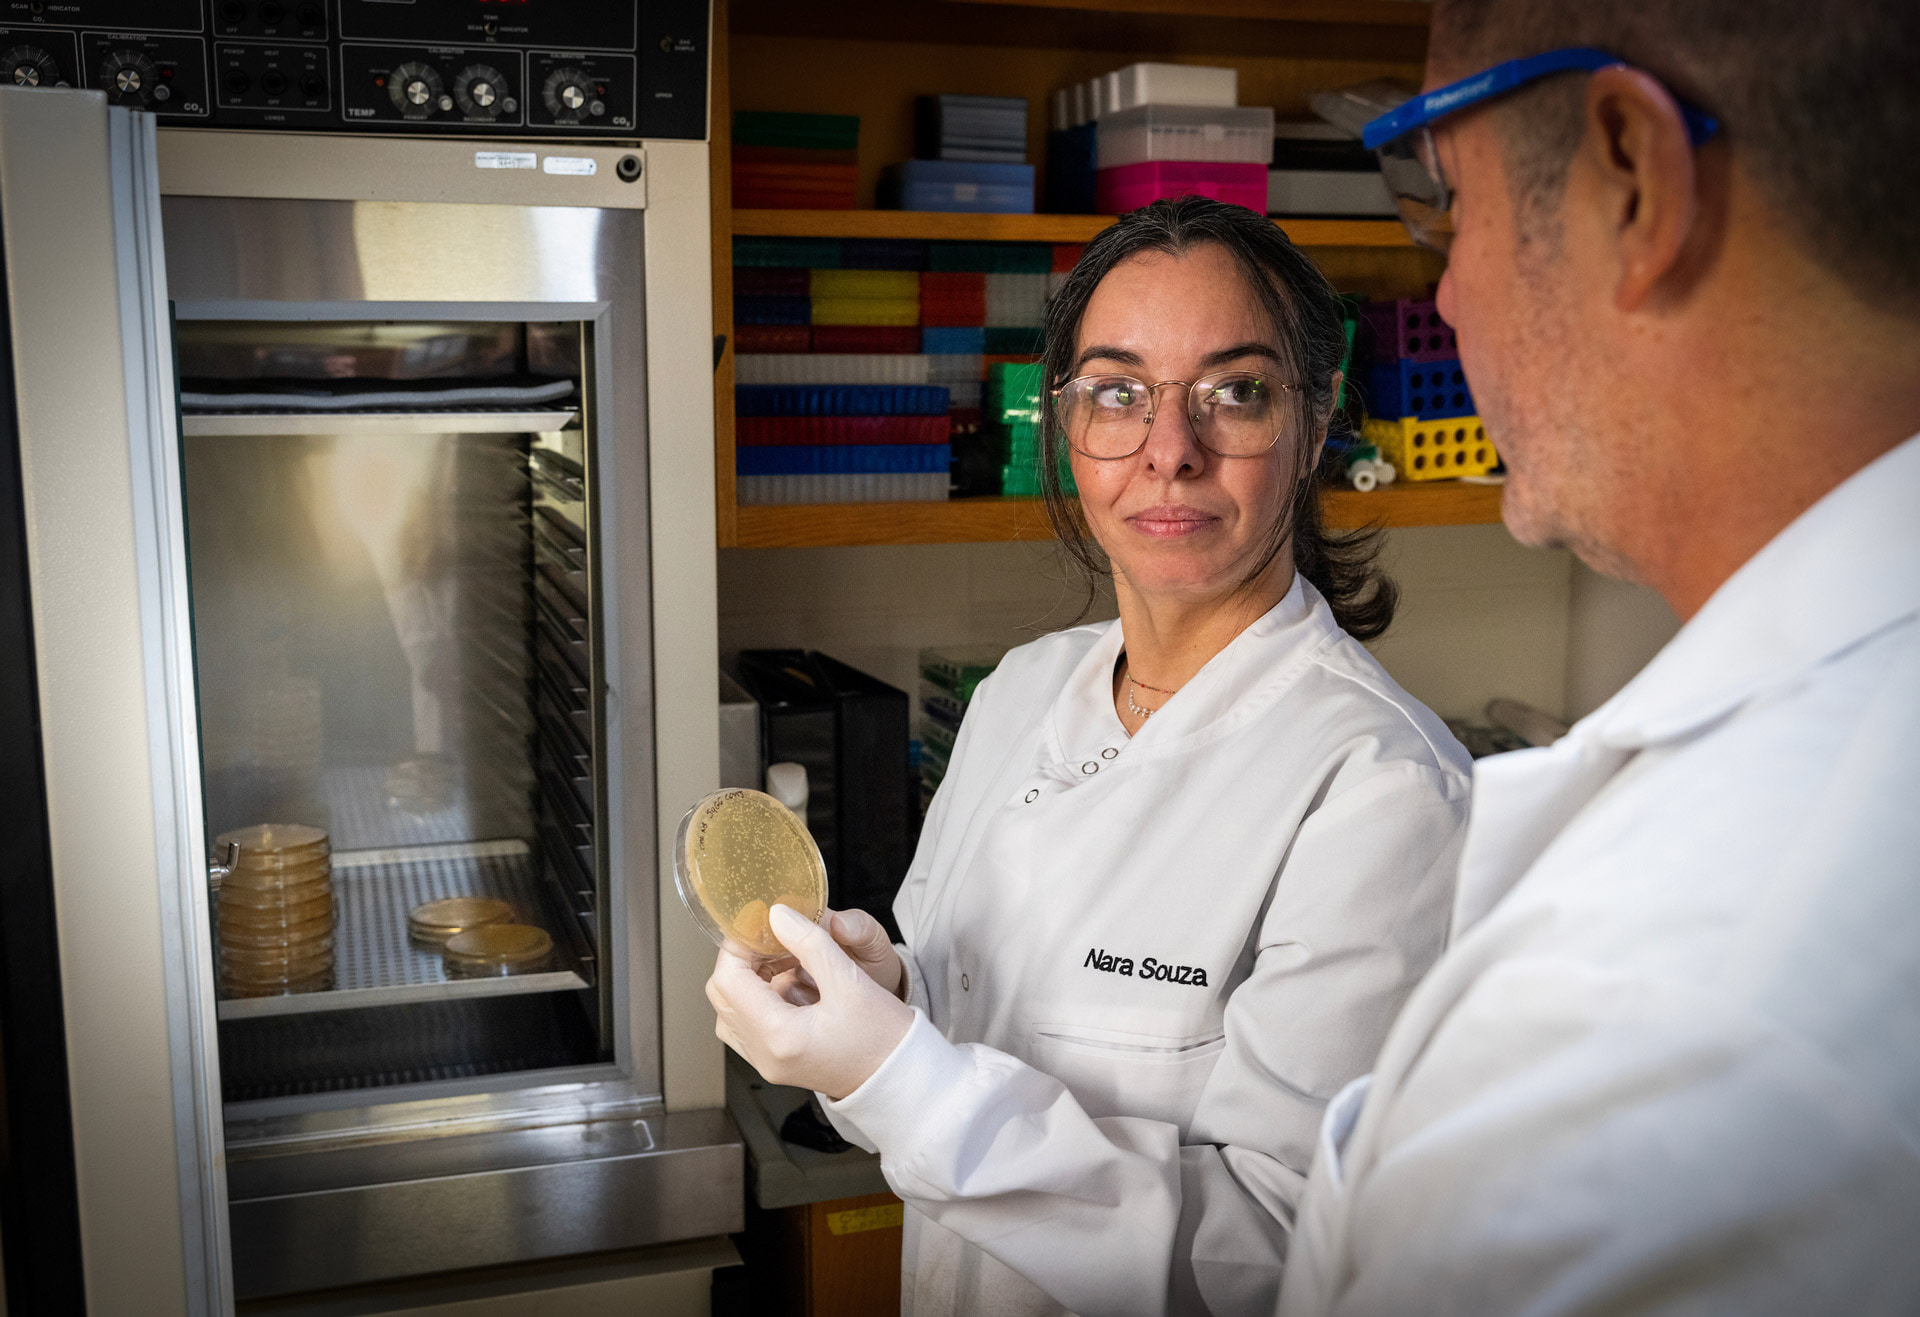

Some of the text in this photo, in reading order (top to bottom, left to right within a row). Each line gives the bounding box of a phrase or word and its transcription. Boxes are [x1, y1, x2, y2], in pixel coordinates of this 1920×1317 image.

[47, 4, 80, 12] INDICATOR
[183, 102, 203, 113] CO2
[348, 107, 376, 117] TEMP
[612, 116, 630, 127] CO2
[1083, 948, 1209, 987] Nara Souza
